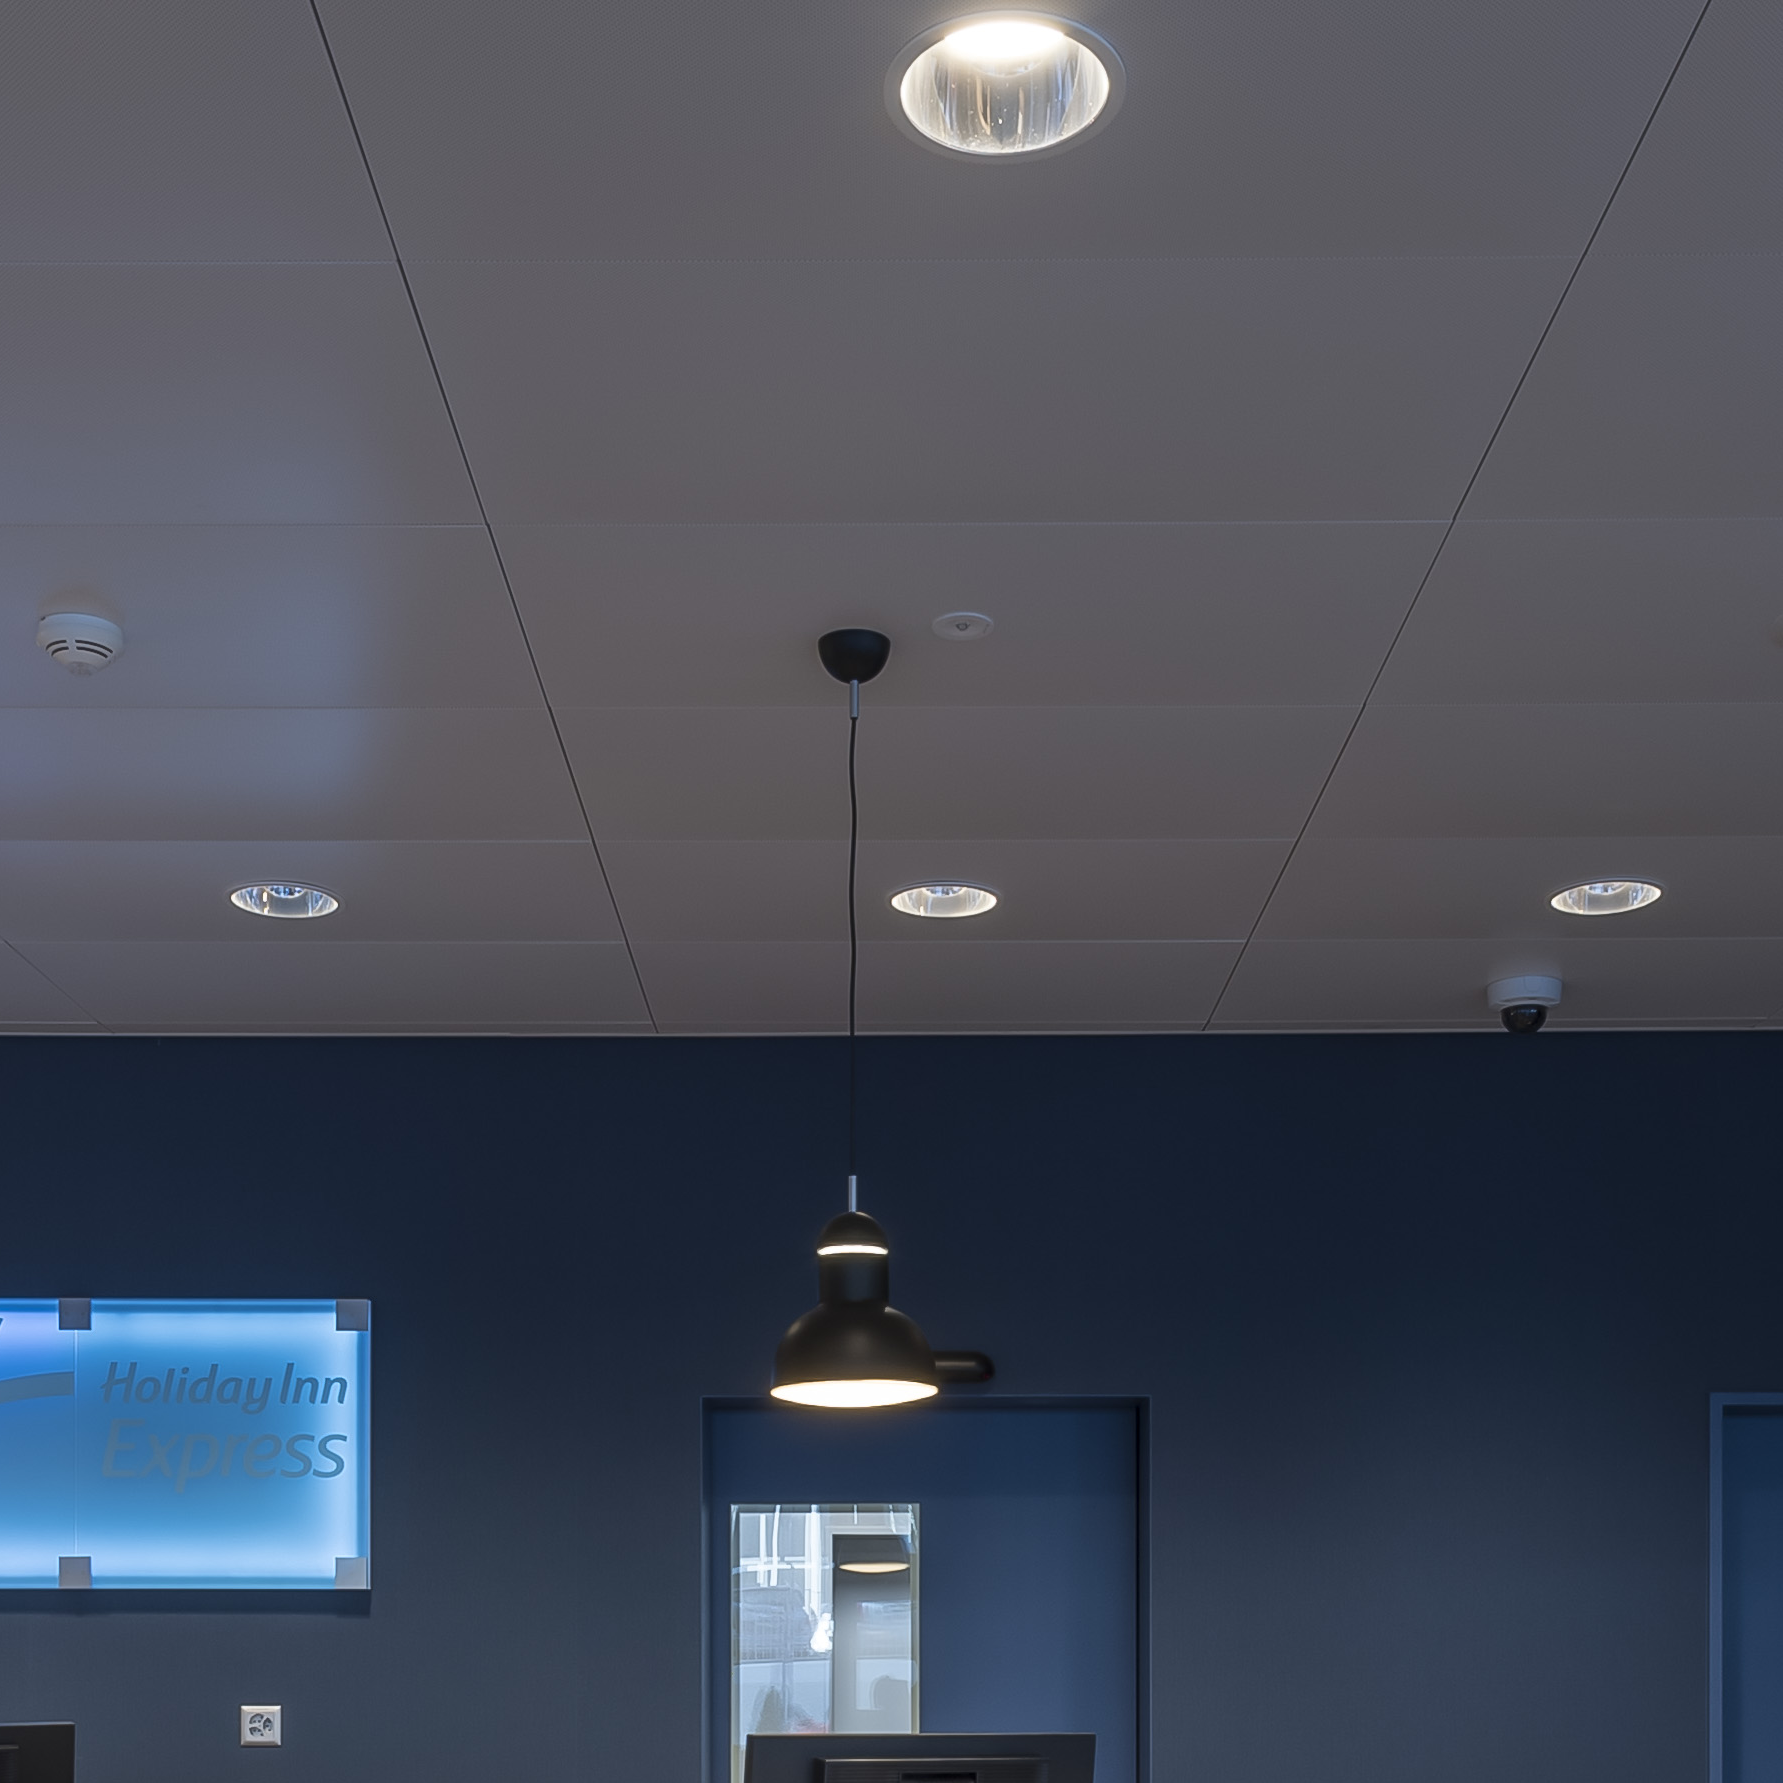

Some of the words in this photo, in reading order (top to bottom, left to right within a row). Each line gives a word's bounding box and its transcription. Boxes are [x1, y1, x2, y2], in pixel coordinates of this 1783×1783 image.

[100, 1361, 273, 1414] Holiday
[280, 1362, 348, 1405] Inn
[100, 1420, 348, 1493] Express
